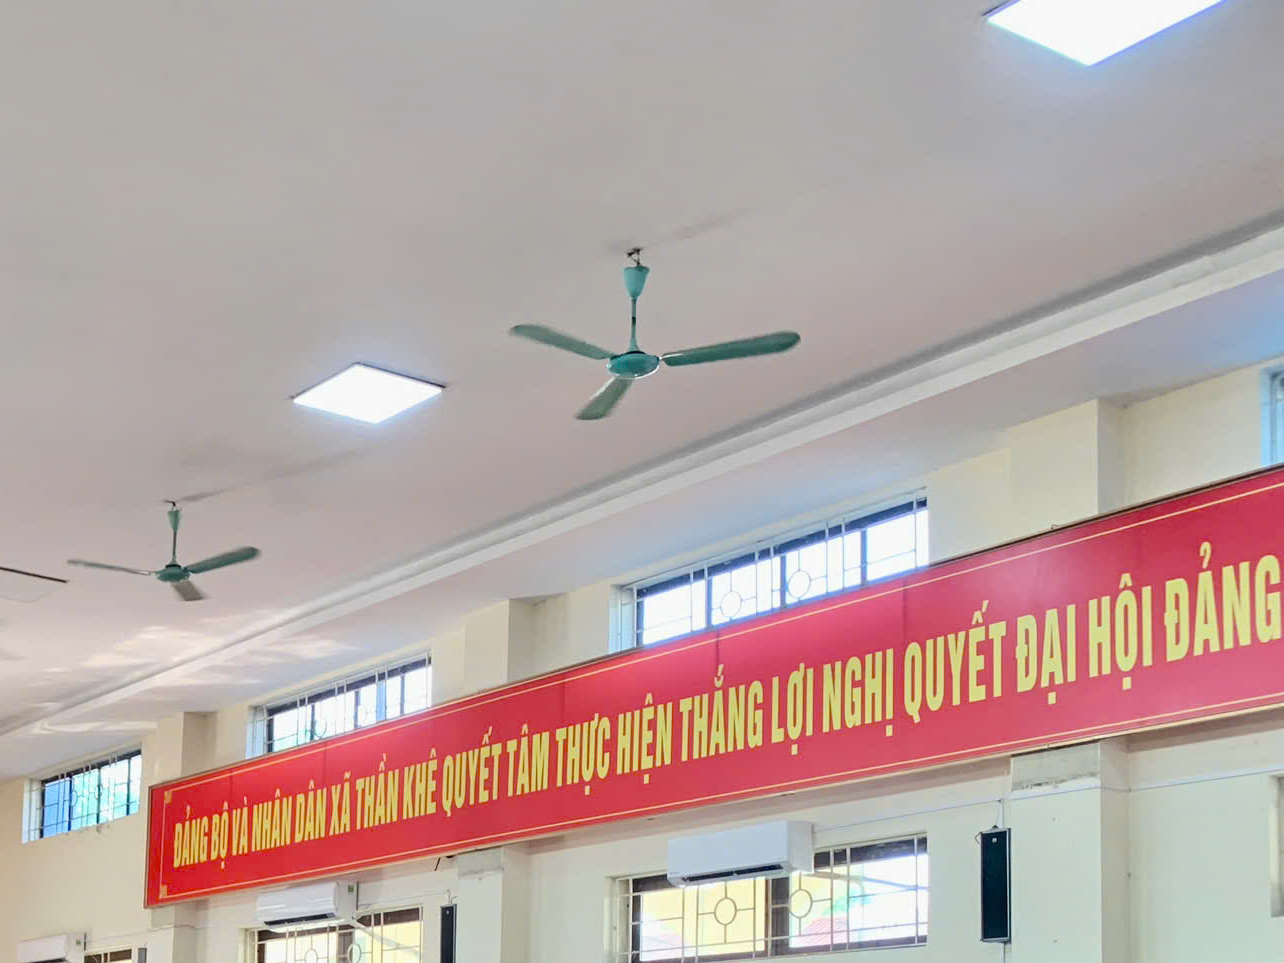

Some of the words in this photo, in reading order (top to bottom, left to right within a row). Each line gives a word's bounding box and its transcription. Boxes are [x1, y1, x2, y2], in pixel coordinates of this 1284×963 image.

[173, 805, 208, 869] ĐẢNG
[210, 803, 230, 870] BỘ
[230, 796, 249, 857] VÀ
[251, 788, 291, 851] NHÂN
[295, 779, 326, 845] DÂN
[329, 772, 351, 836] XÃ
[356, 753, 399, 831] THẦN
[402, 747, 438, 820] KHÊ
[441, 725, 502, 818] QUYẾT
[506, 723, 550, 796] TÂM
[555, 711, 611, 796] THỰC
[616, 693, 672, 784] HIỆN
[679, 664, 764, 762] THẮNG
[770, 663, 814, 755] LỢI
[822, 647, 895, 737] NGHỊ
[903, 599, 1007, 724] QUYẾT
[1015, 603, 1077, 705] ĐẠI
[1087, 572, 1153, 690] HỘI
[1162, 540, 1282, 663] ĐẢNG
